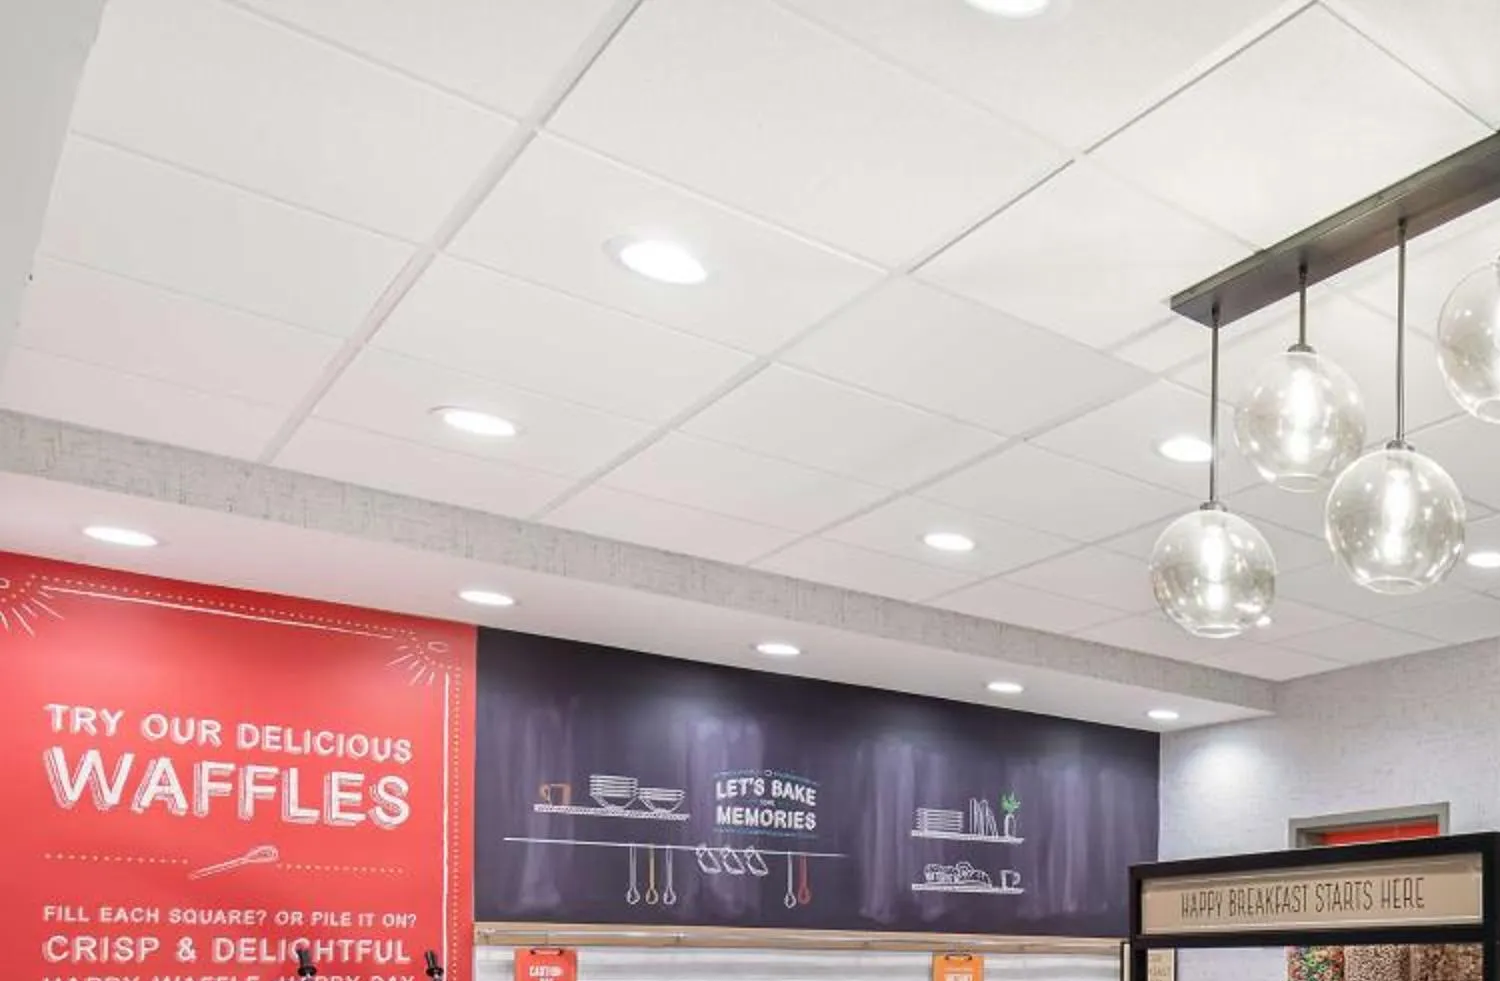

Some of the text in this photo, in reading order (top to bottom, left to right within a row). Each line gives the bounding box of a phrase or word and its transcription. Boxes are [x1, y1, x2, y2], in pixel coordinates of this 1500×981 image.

[45, 703, 413, 764] TRY OUR DELICIOUS
[44, 746, 412, 831] WAFFLES
[715, 777, 817, 807] LET'S BAKE
[716, 805, 817, 831] MEMORIES
[1180, 876, 1426, 920] HAPPY BREAKFAST STARTS HERE
[43, 904, 417, 929] FILL EACH SQUARE? OR PILE IT ON?
[42, 934, 160, 963] CRISP
[176, 935, 197, 963] &
